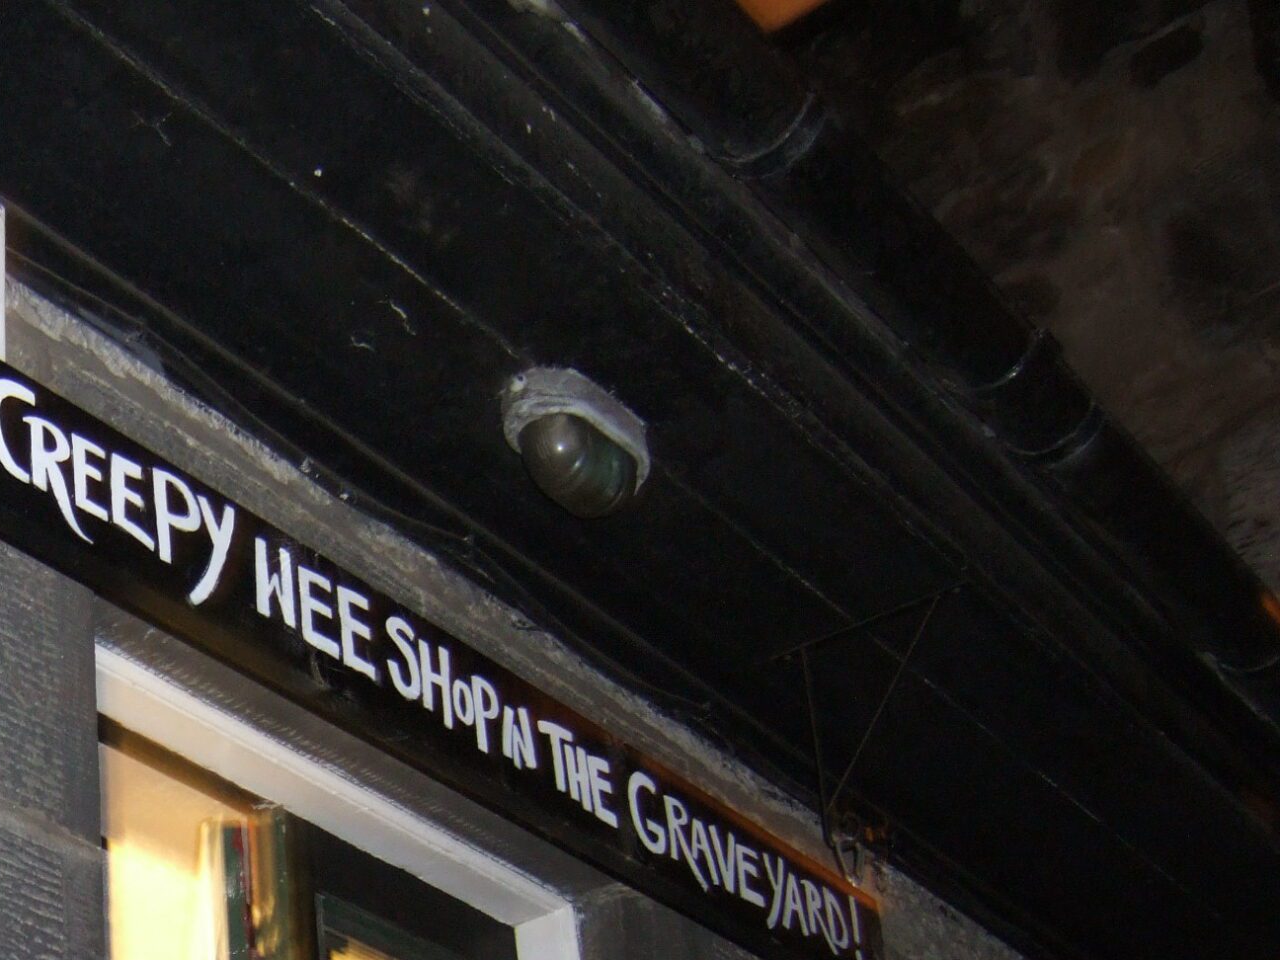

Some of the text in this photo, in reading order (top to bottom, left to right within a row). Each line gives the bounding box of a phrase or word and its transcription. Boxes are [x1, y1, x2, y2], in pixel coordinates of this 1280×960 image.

[254, 537, 380, 681] WEE
[502, 704, 537, 770] IN
[537, 720, 618, 828] THE
